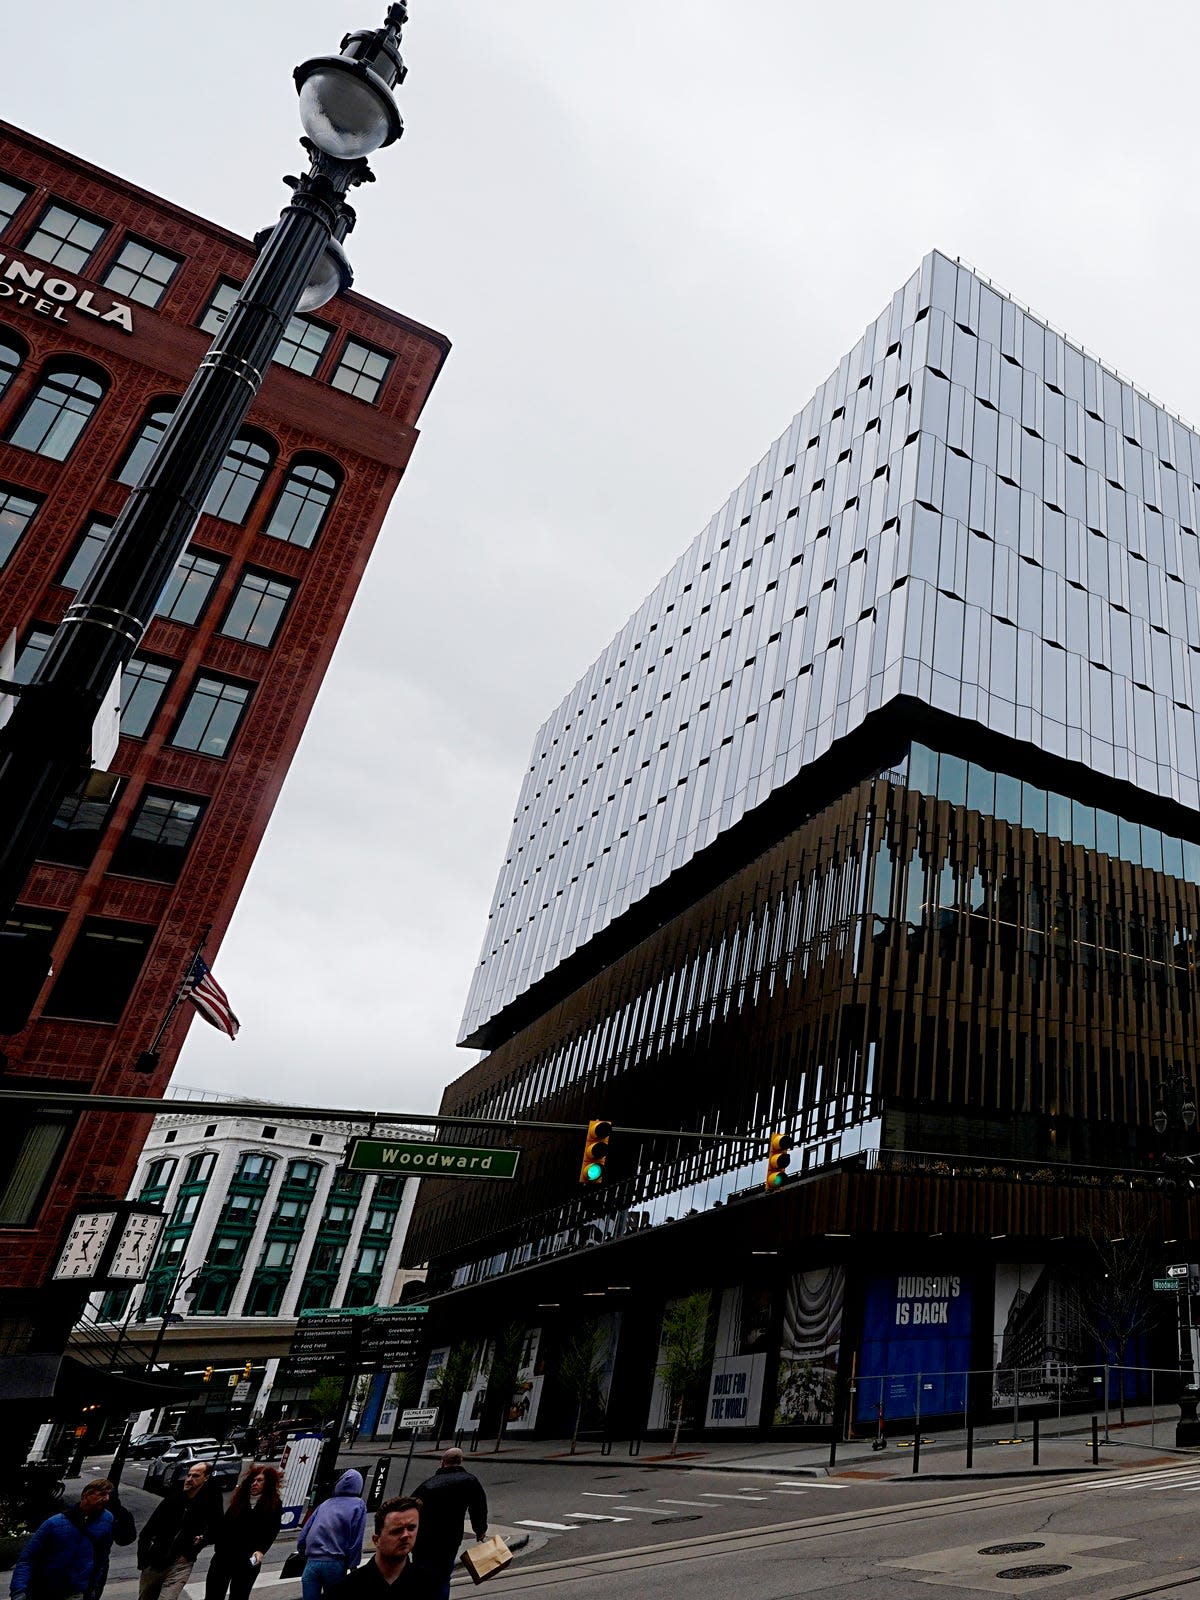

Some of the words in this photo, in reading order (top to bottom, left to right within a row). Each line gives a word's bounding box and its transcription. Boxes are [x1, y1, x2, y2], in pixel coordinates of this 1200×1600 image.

[0, 253, 134, 333] NOLA
[382, 1148, 493, 1169] Woodward
[896, 1275, 961, 1298] HUDSON'S
[896, 1302, 909, 1325] IS
[913, 1302, 949, 1324] BACK
[713, 1374, 733, 1395] BUILT
[733, 1372, 746, 1394] FOR
[710, 1398, 724, 1419] THE
[725, 1398, 748, 1418] WORLD
[374, 1467, 386, 1498] VALET
